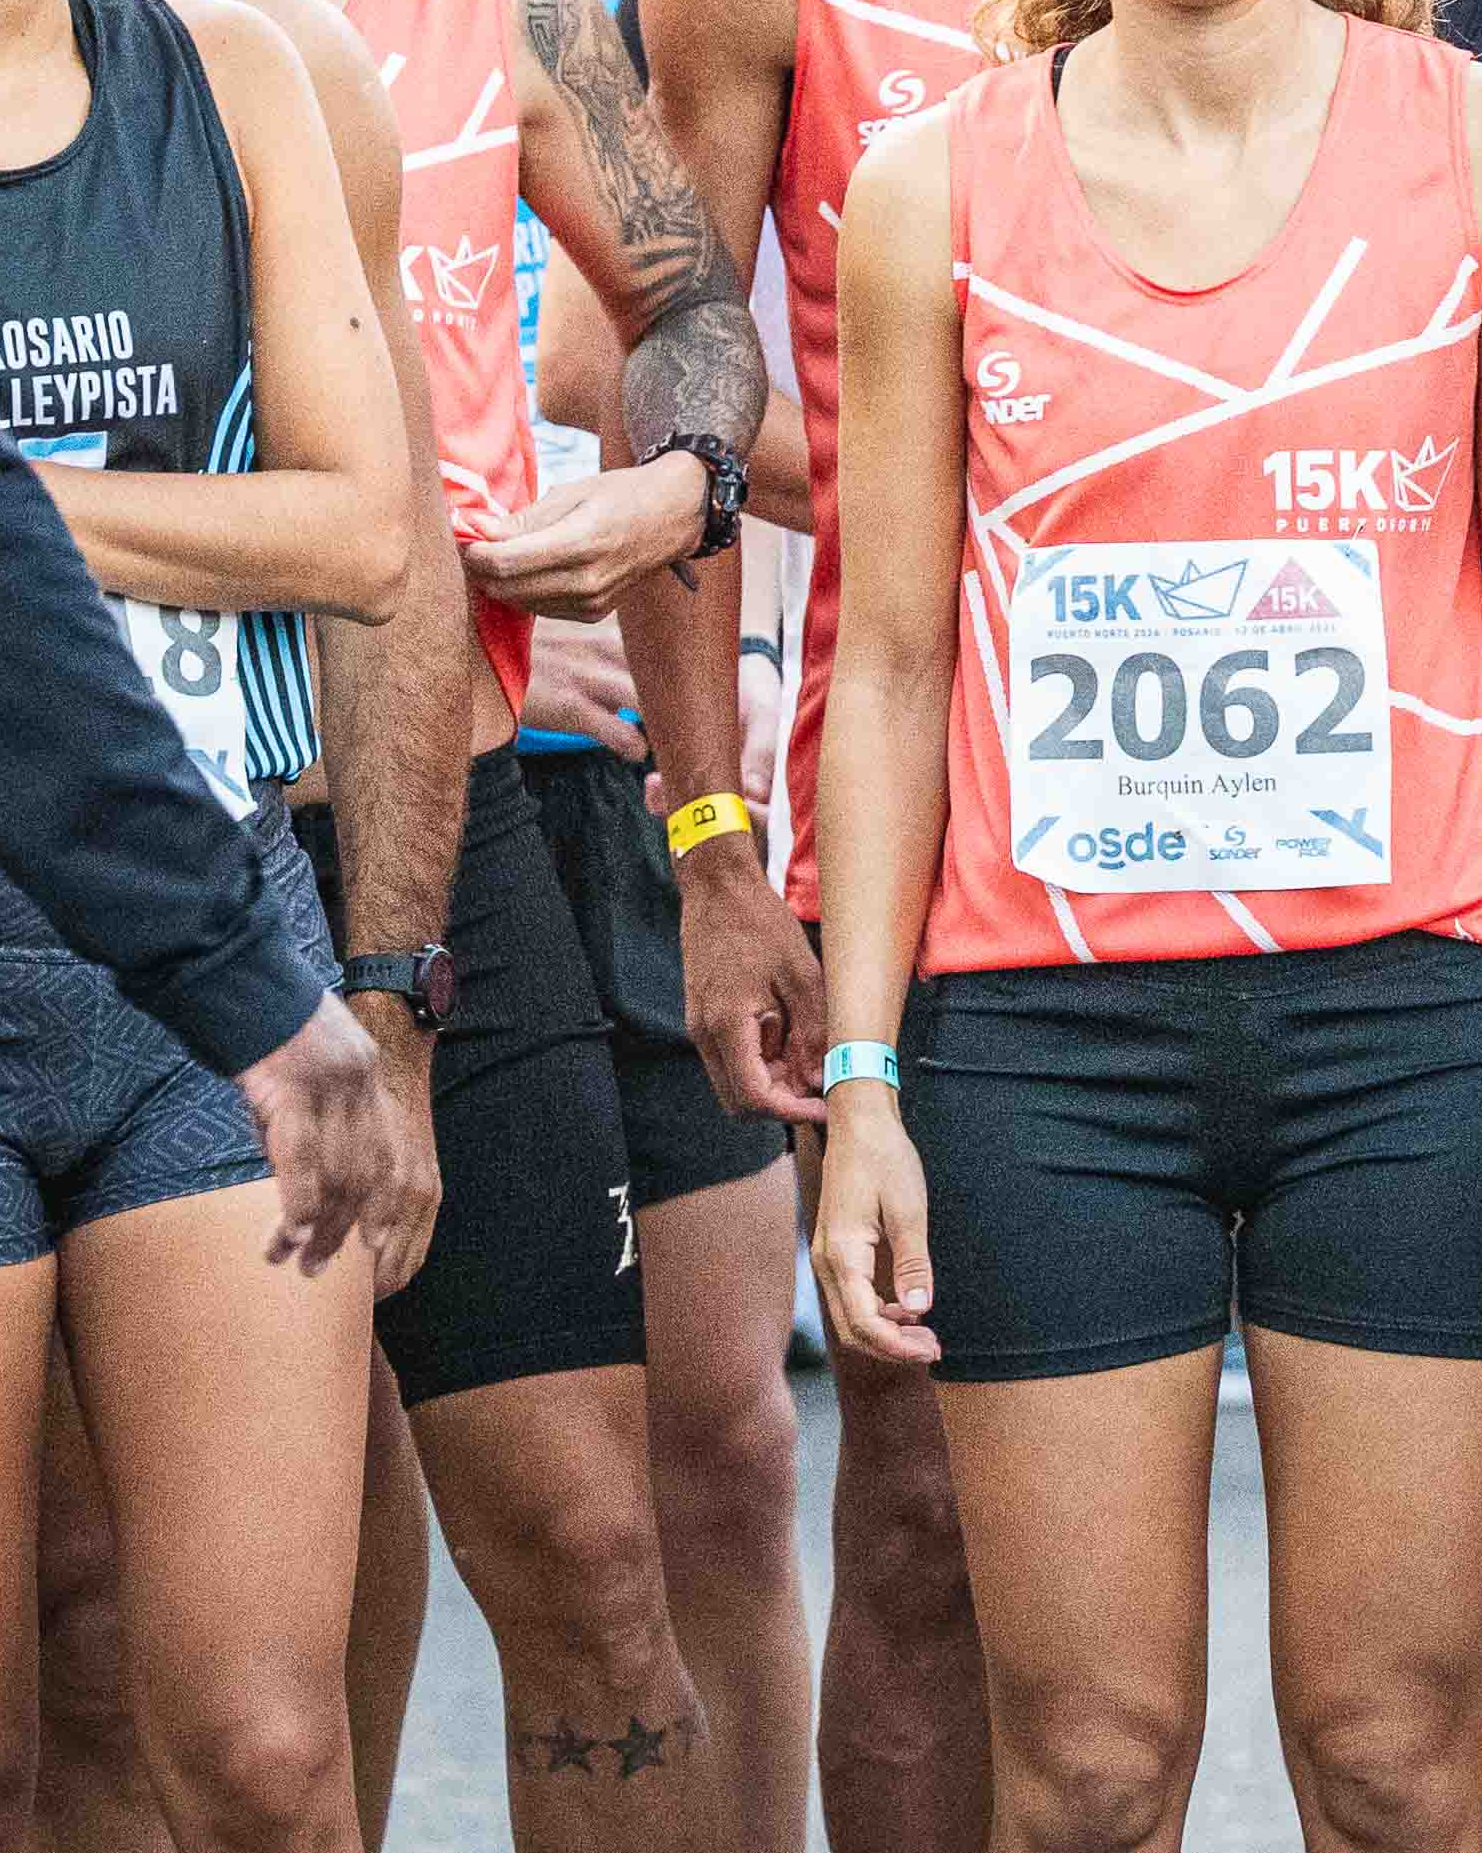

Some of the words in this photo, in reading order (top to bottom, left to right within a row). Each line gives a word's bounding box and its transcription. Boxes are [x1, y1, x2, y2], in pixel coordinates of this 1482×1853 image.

[1263, 449, 1389, 512] 15K
[1047, 573, 1144, 623] 15K
[1268, 586, 1320, 616] 15K
[158, 604, 222, 697] 8
[1029, 646, 1374, 762] 2062
[1117, 774, 1204, 800] Burquin
[1211, 772, 1278, 799] Aylen
[1067, 820, 1187, 870] osde
